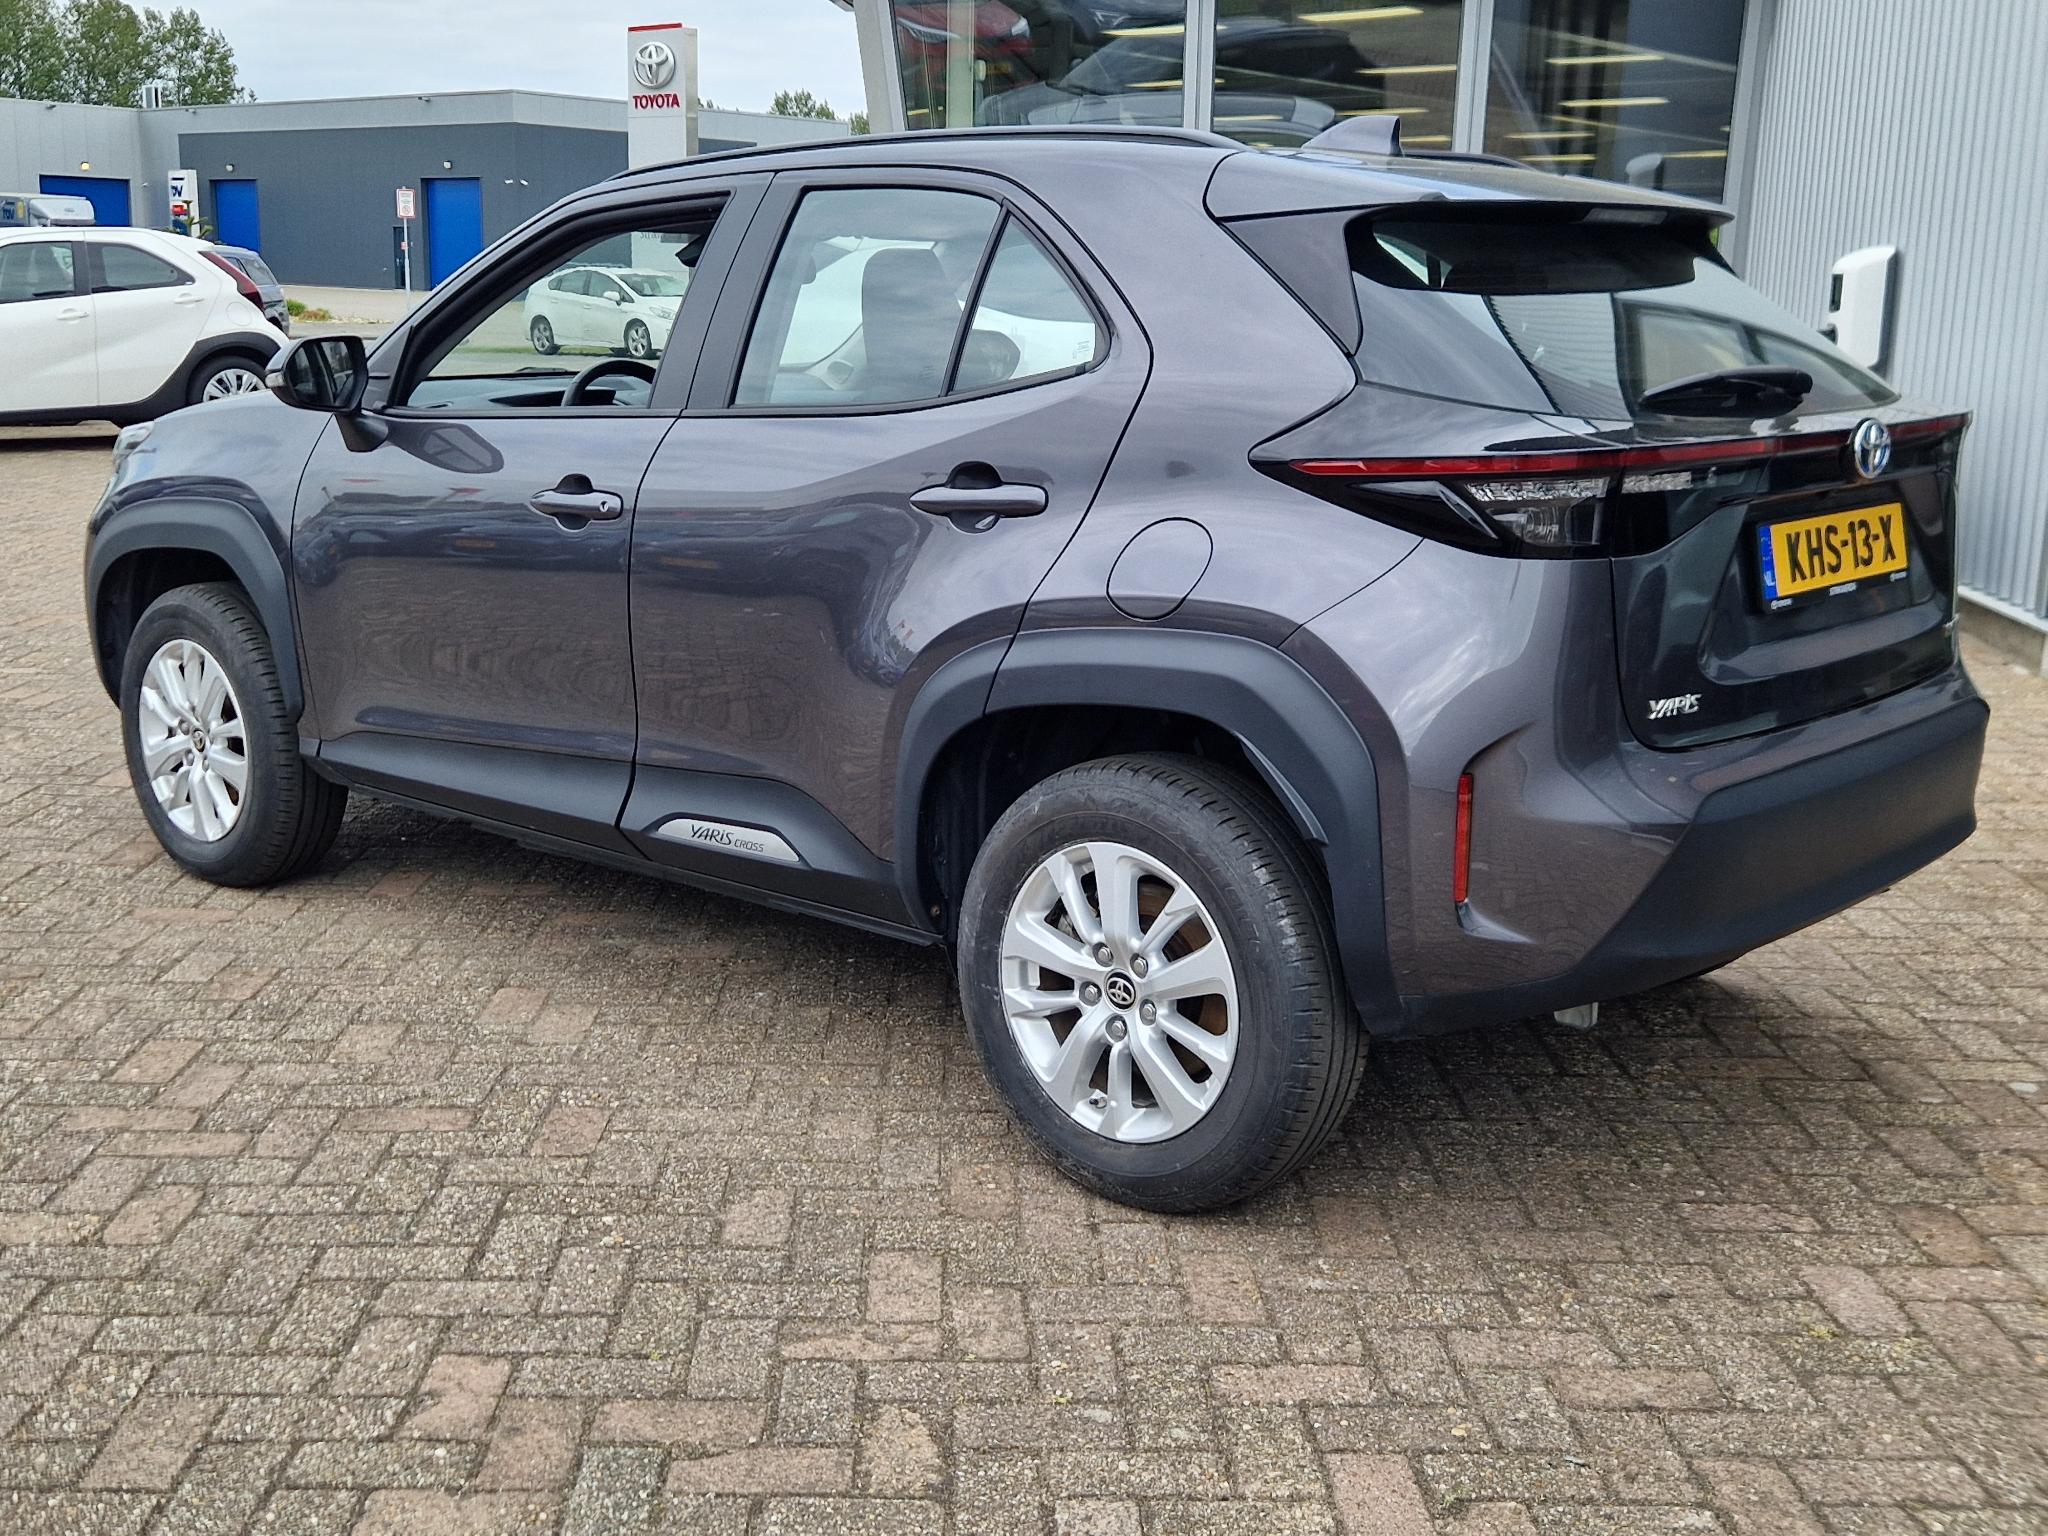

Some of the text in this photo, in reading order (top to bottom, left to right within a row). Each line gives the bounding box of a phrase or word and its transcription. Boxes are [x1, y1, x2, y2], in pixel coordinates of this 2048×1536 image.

[632, 93, 680, 109] TOYOTA
[1785, 513, 1897, 583] KHS-13-X
[734, 838, 764, 853] CROSS
